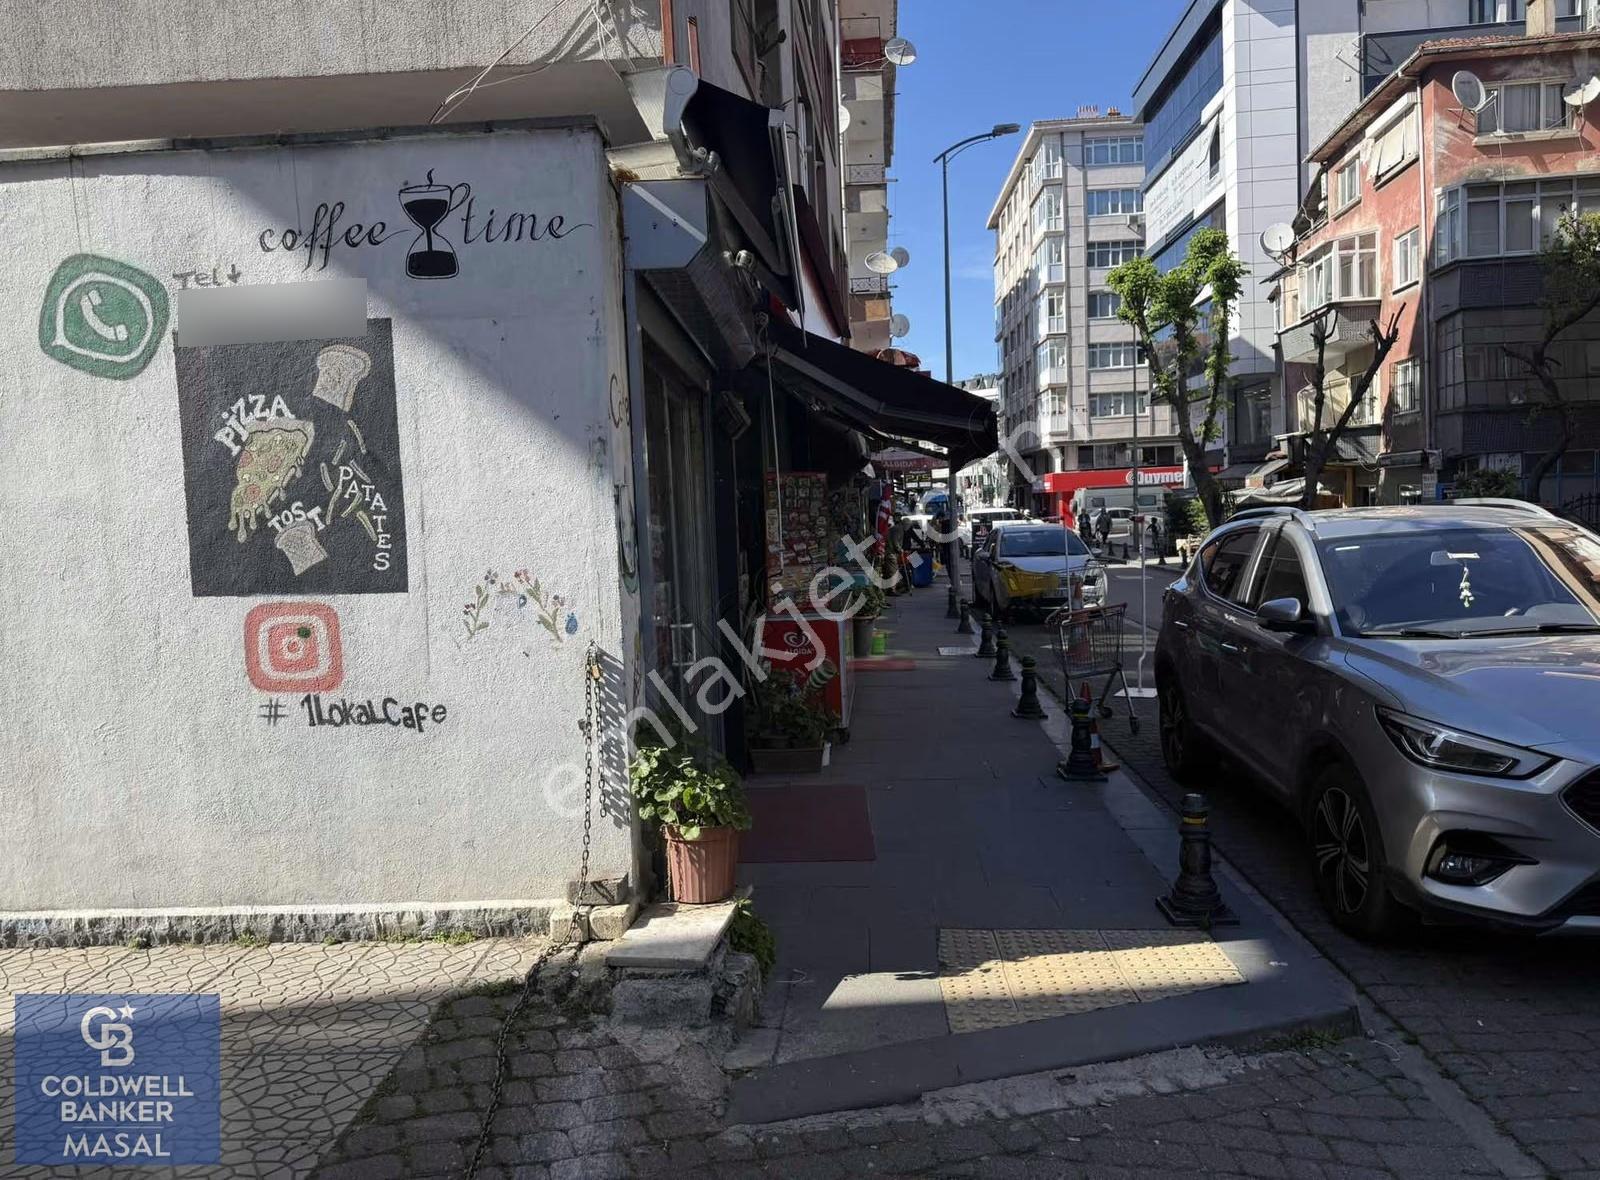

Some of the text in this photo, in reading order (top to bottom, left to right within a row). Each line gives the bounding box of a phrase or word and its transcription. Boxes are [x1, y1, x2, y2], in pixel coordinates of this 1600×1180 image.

[258, 195, 593, 272] coffee time
[1137, 470, 1185, 485] Duyme
[267, 501, 327, 533] TOST
